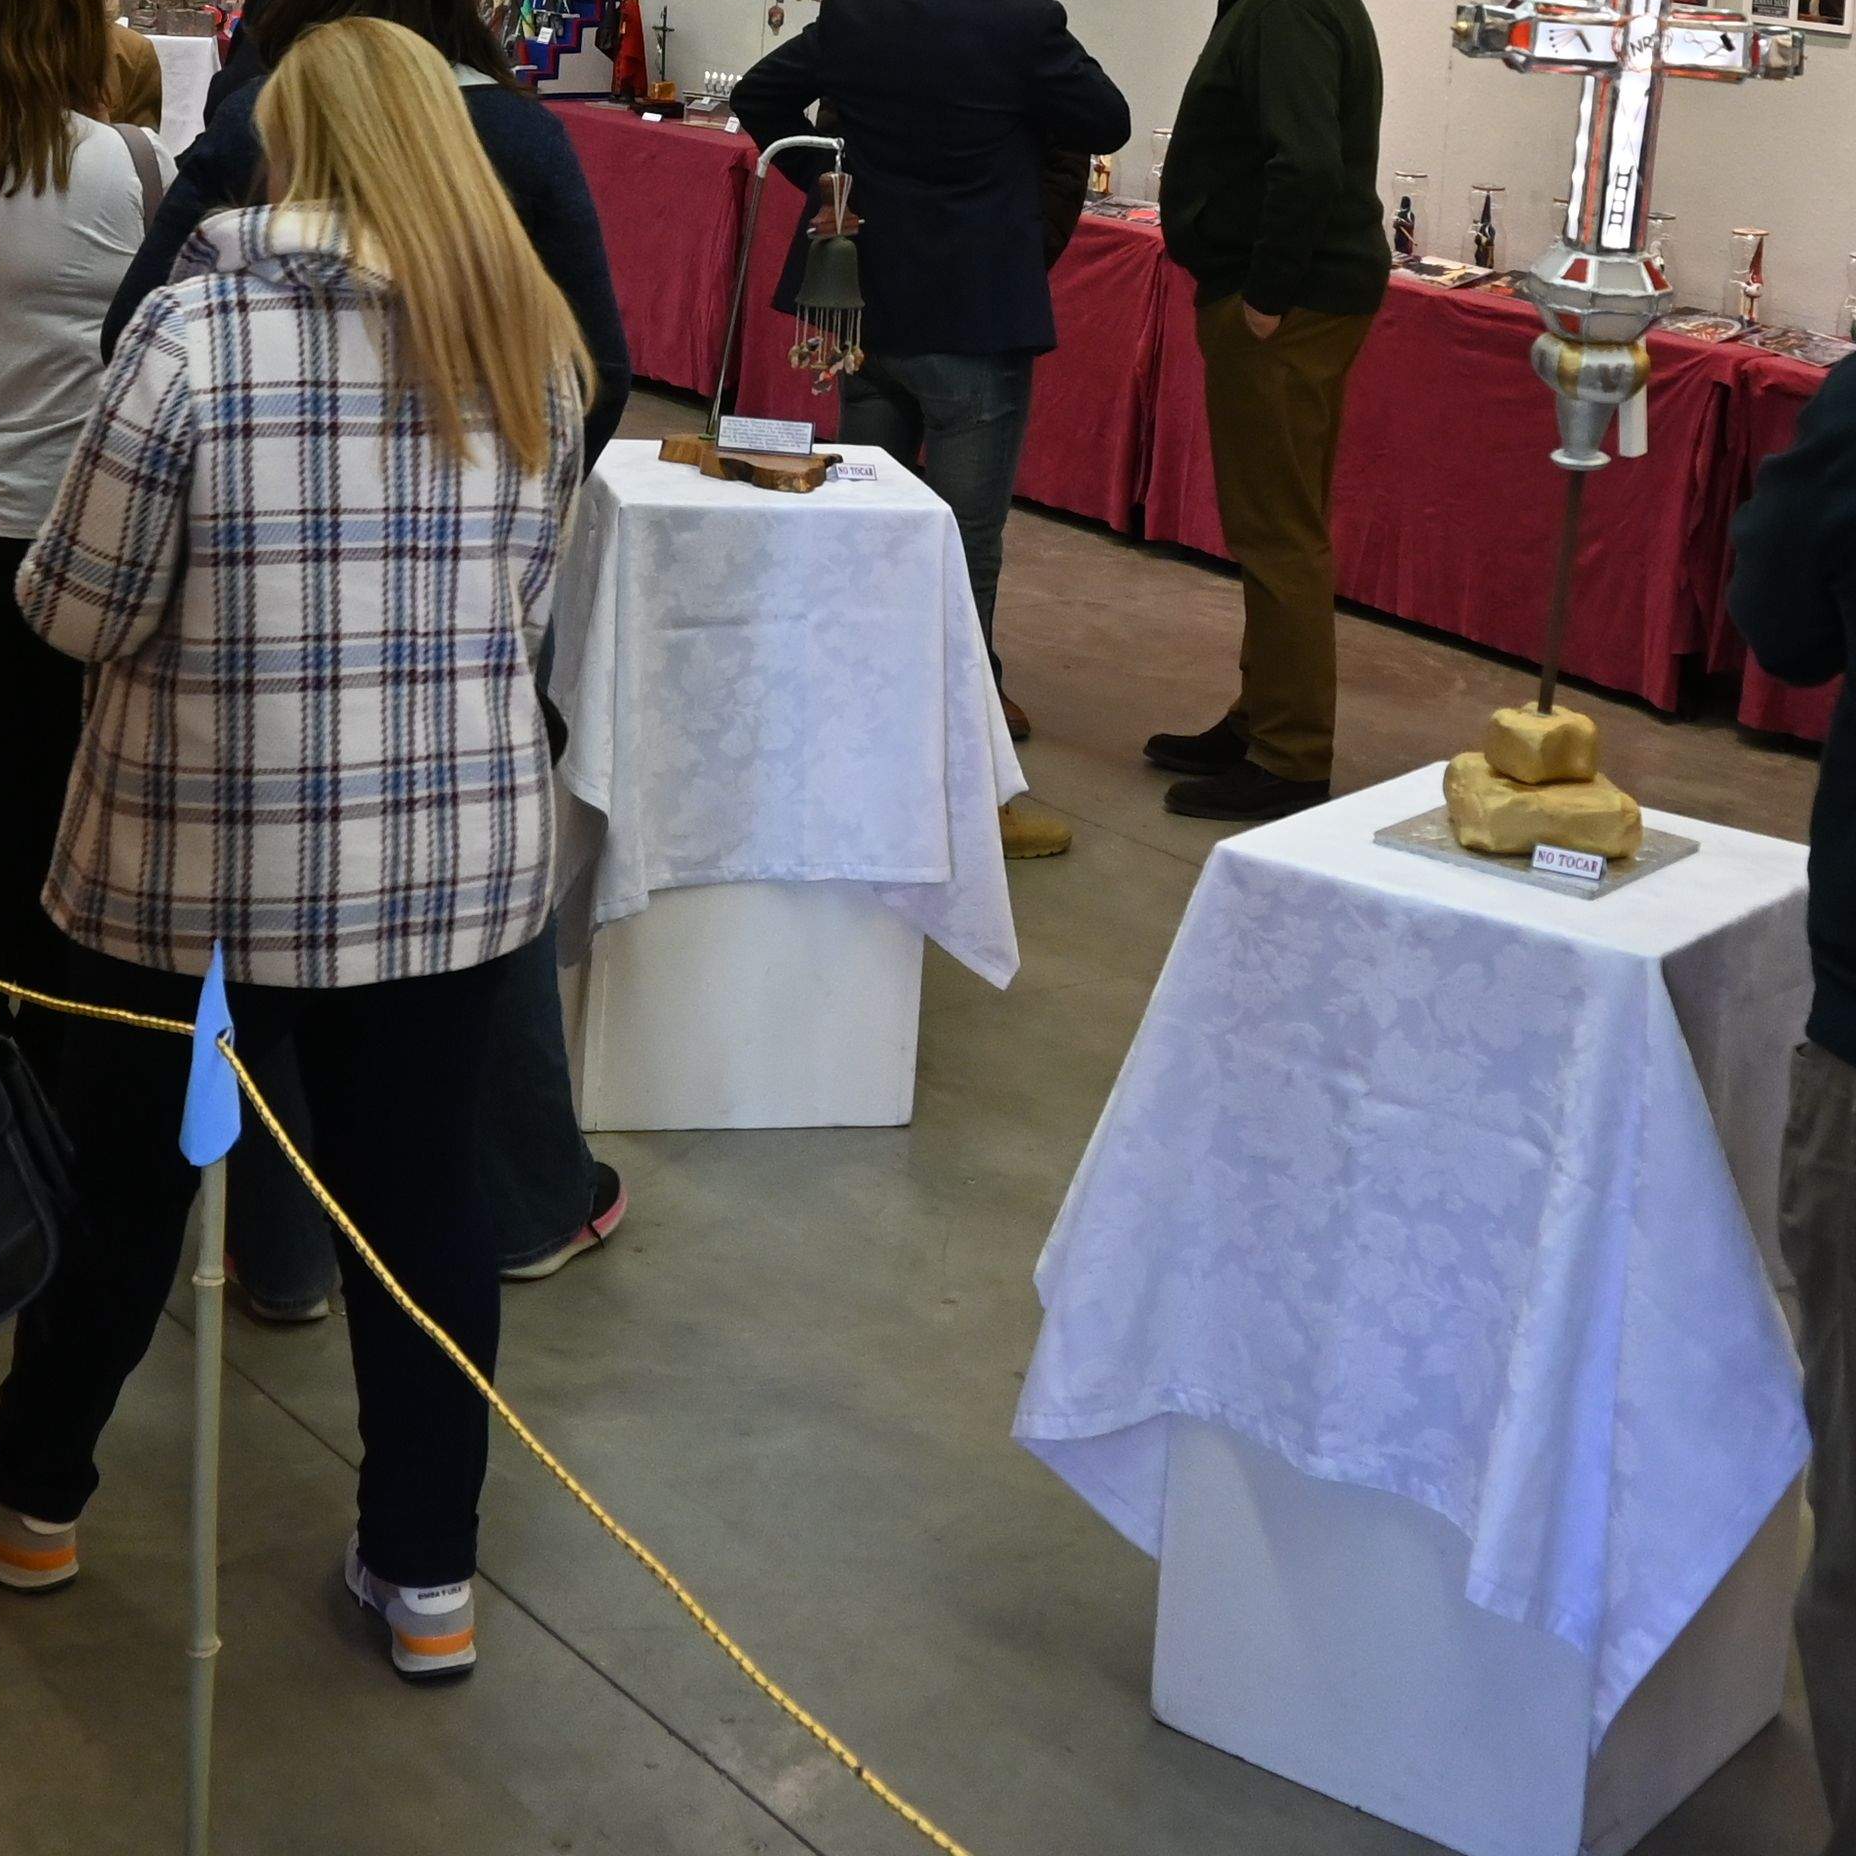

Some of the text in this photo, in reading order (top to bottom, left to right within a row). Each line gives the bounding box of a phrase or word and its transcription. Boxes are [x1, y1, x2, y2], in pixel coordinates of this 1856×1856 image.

[838, 466, 873, 476] NO TOCAR
[1537, 849, 1599, 873] NO TOCAR
